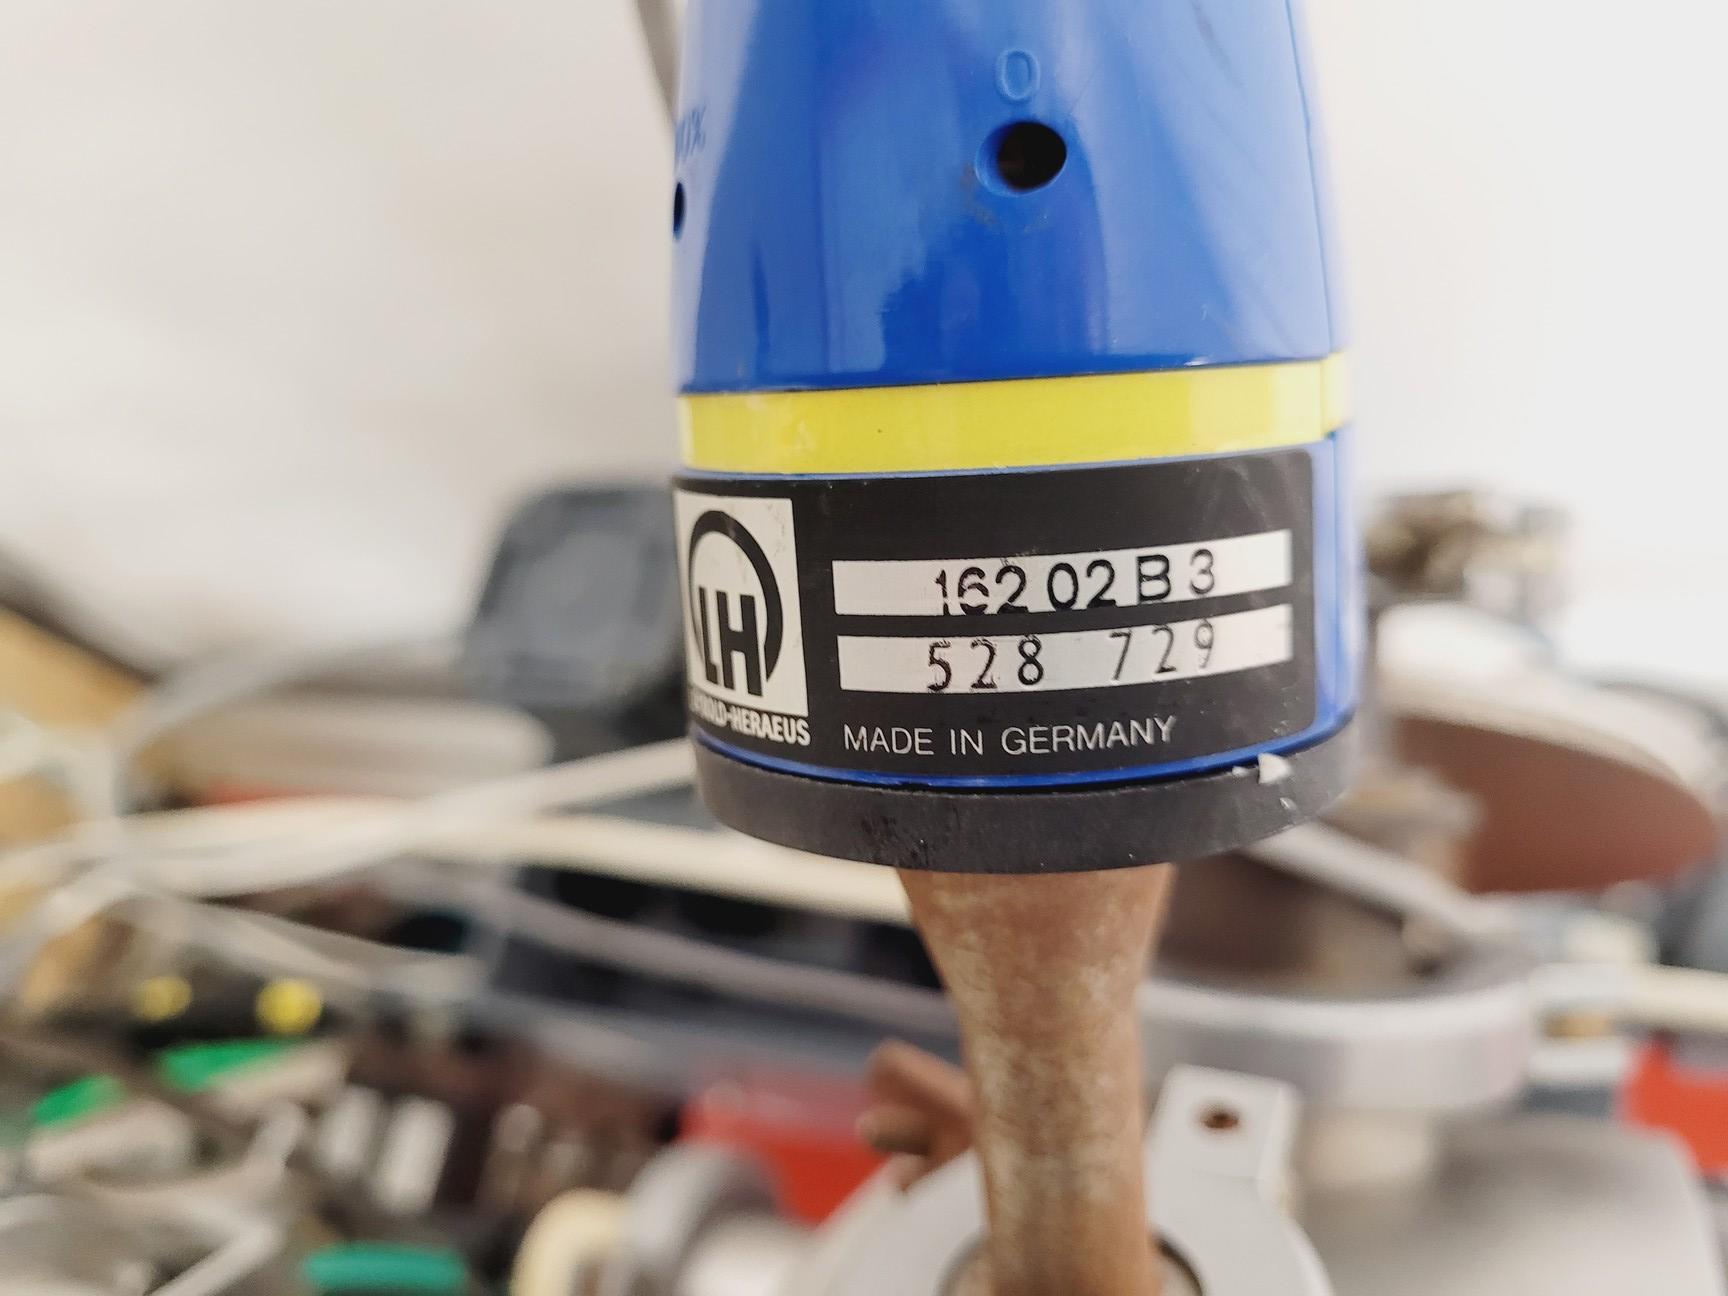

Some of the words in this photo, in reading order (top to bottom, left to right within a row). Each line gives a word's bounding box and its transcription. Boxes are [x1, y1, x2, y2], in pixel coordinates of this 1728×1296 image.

[927, 633, 1044, 692] 528
[1109, 617, 1215, 683] 729
[843, 724, 934, 755] MADE
[950, 729, 984, 756] IN
[1001, 715, 1177, 755] GERMANY
